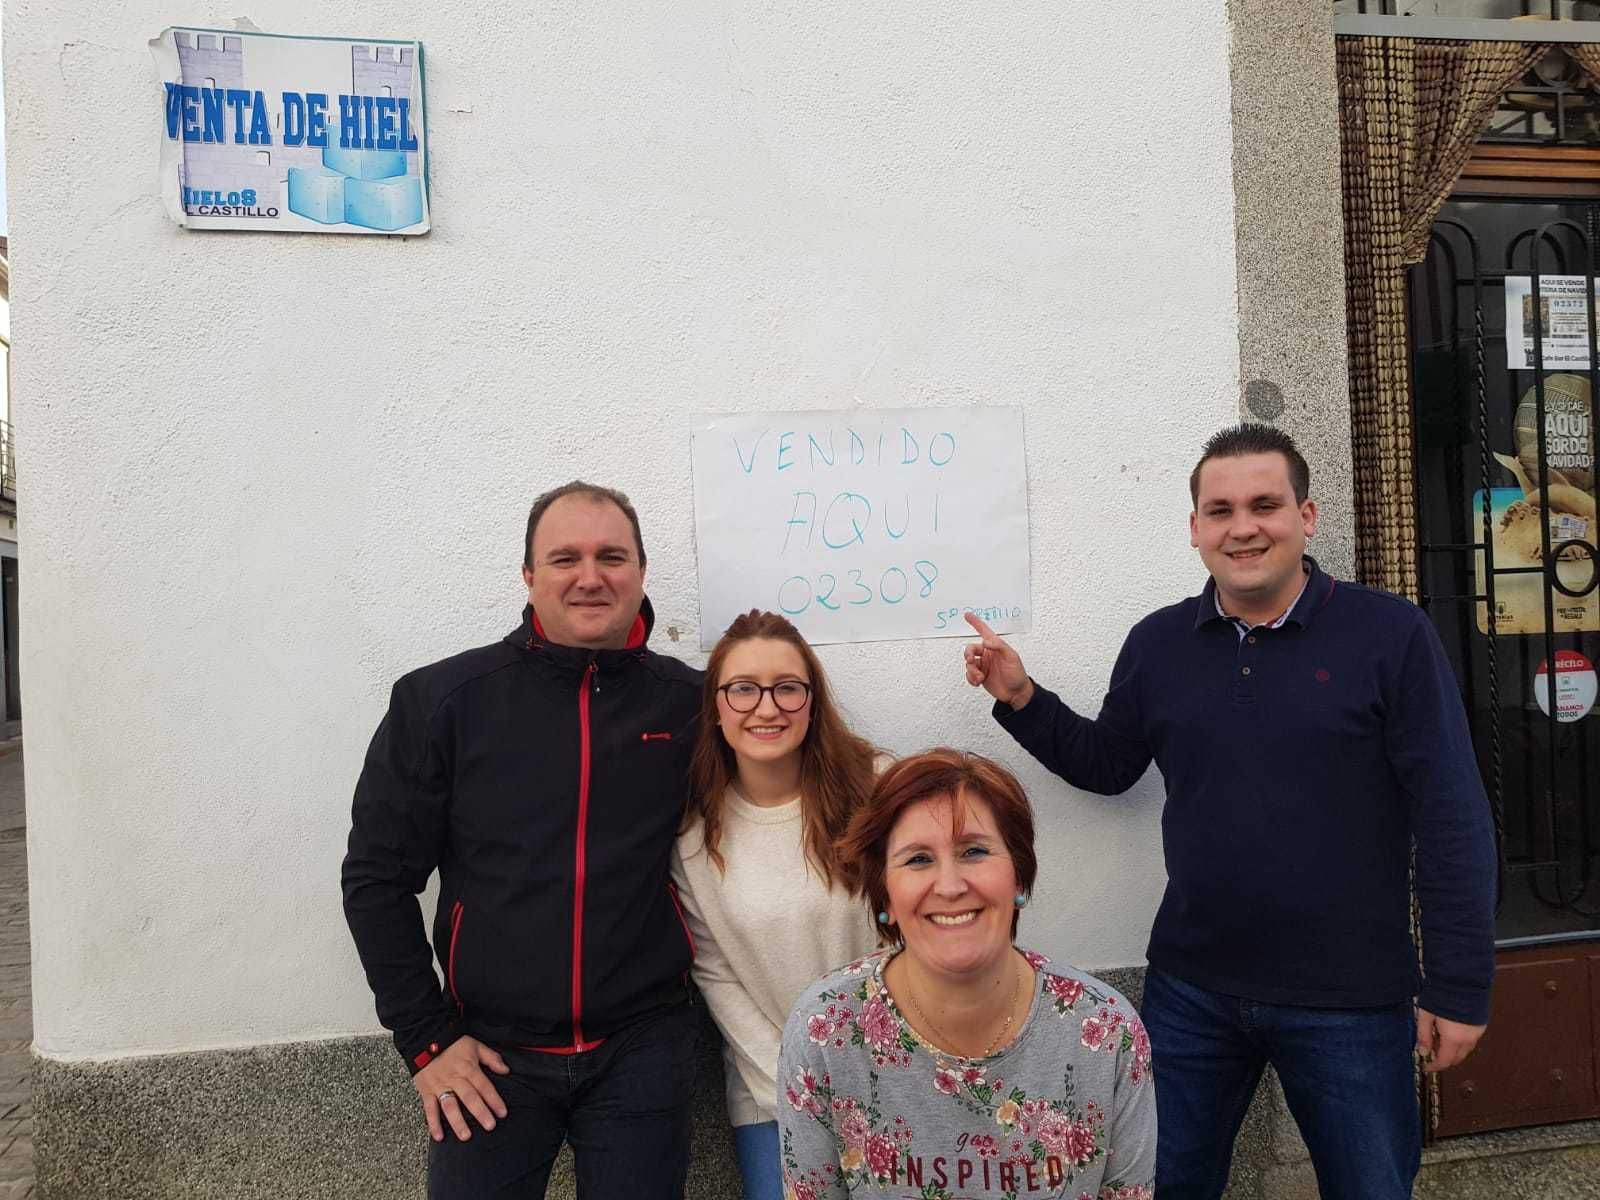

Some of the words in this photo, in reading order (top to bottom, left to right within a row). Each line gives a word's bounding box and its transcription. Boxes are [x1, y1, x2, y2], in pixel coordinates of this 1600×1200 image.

[164, 81, 272, 146] VENTA
[282, 91, 329, 148] DE
[339, 94, 418, 151] HIEL
[186, 206, 194, 215] L
[198, 205, 279, 217] CASTILLO
[732, 427, 957, 473] VENDIDO
[781, 491, 942, 560] AQUI
[777, 560, 939, 615] 02308
[1556, 704, 1584, 712] ANAMOS
[890, 1154, 1065, 1192] INSPIRED
